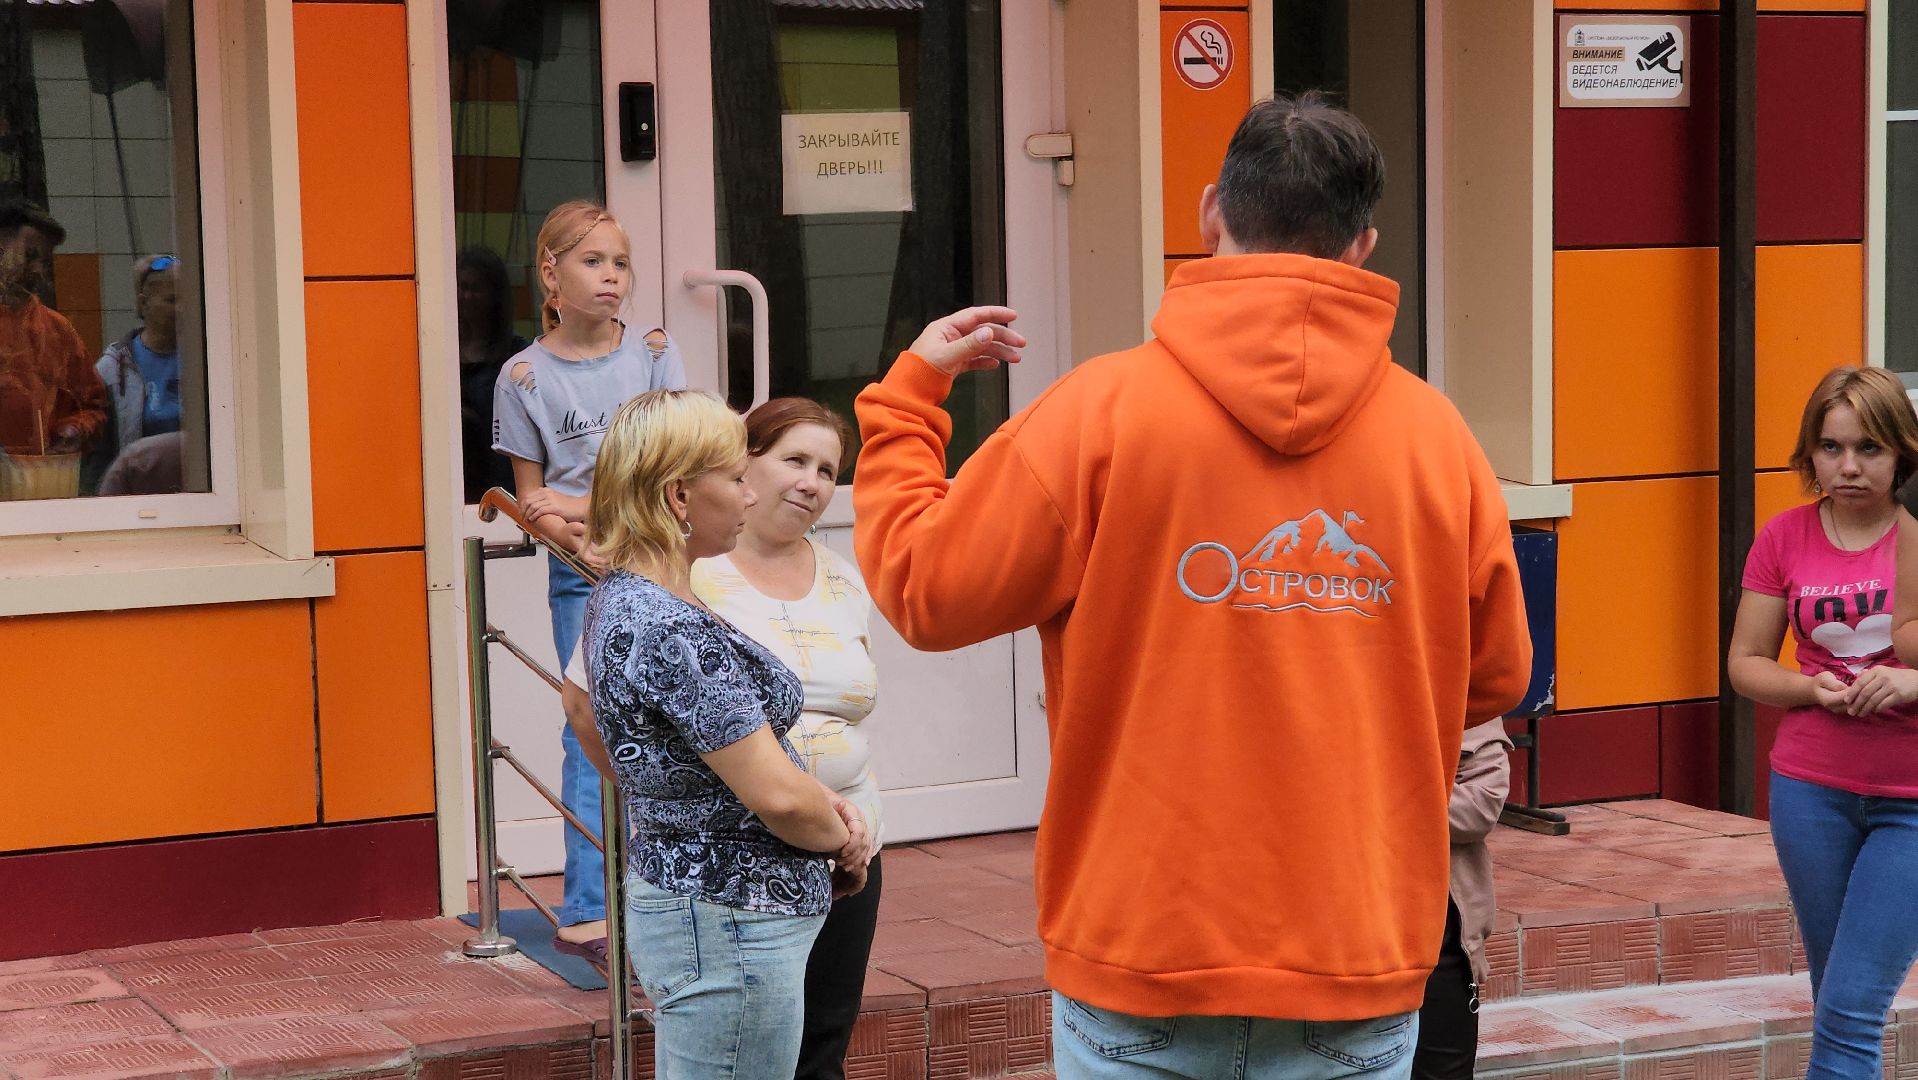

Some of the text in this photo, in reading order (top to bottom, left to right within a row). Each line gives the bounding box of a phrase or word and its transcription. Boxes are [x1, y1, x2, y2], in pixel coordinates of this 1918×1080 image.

[1572, 49, 1623, 59] ВНИМАНИЕ
[1572, 65, 1618, 76] ВЕДЕТСЯ
[1572, 79, 1678, 90] ВИДЕОНАБЛЮДЕНИЕ!
[798, 129, 900, 149] ЗАКРЫВАЙТЕ
[816, 160, 883, 179] ДВЕРЬ!!!
[555, 410, 608, 435] Must
[1800, 579, 1881, 597] BELIEVE
